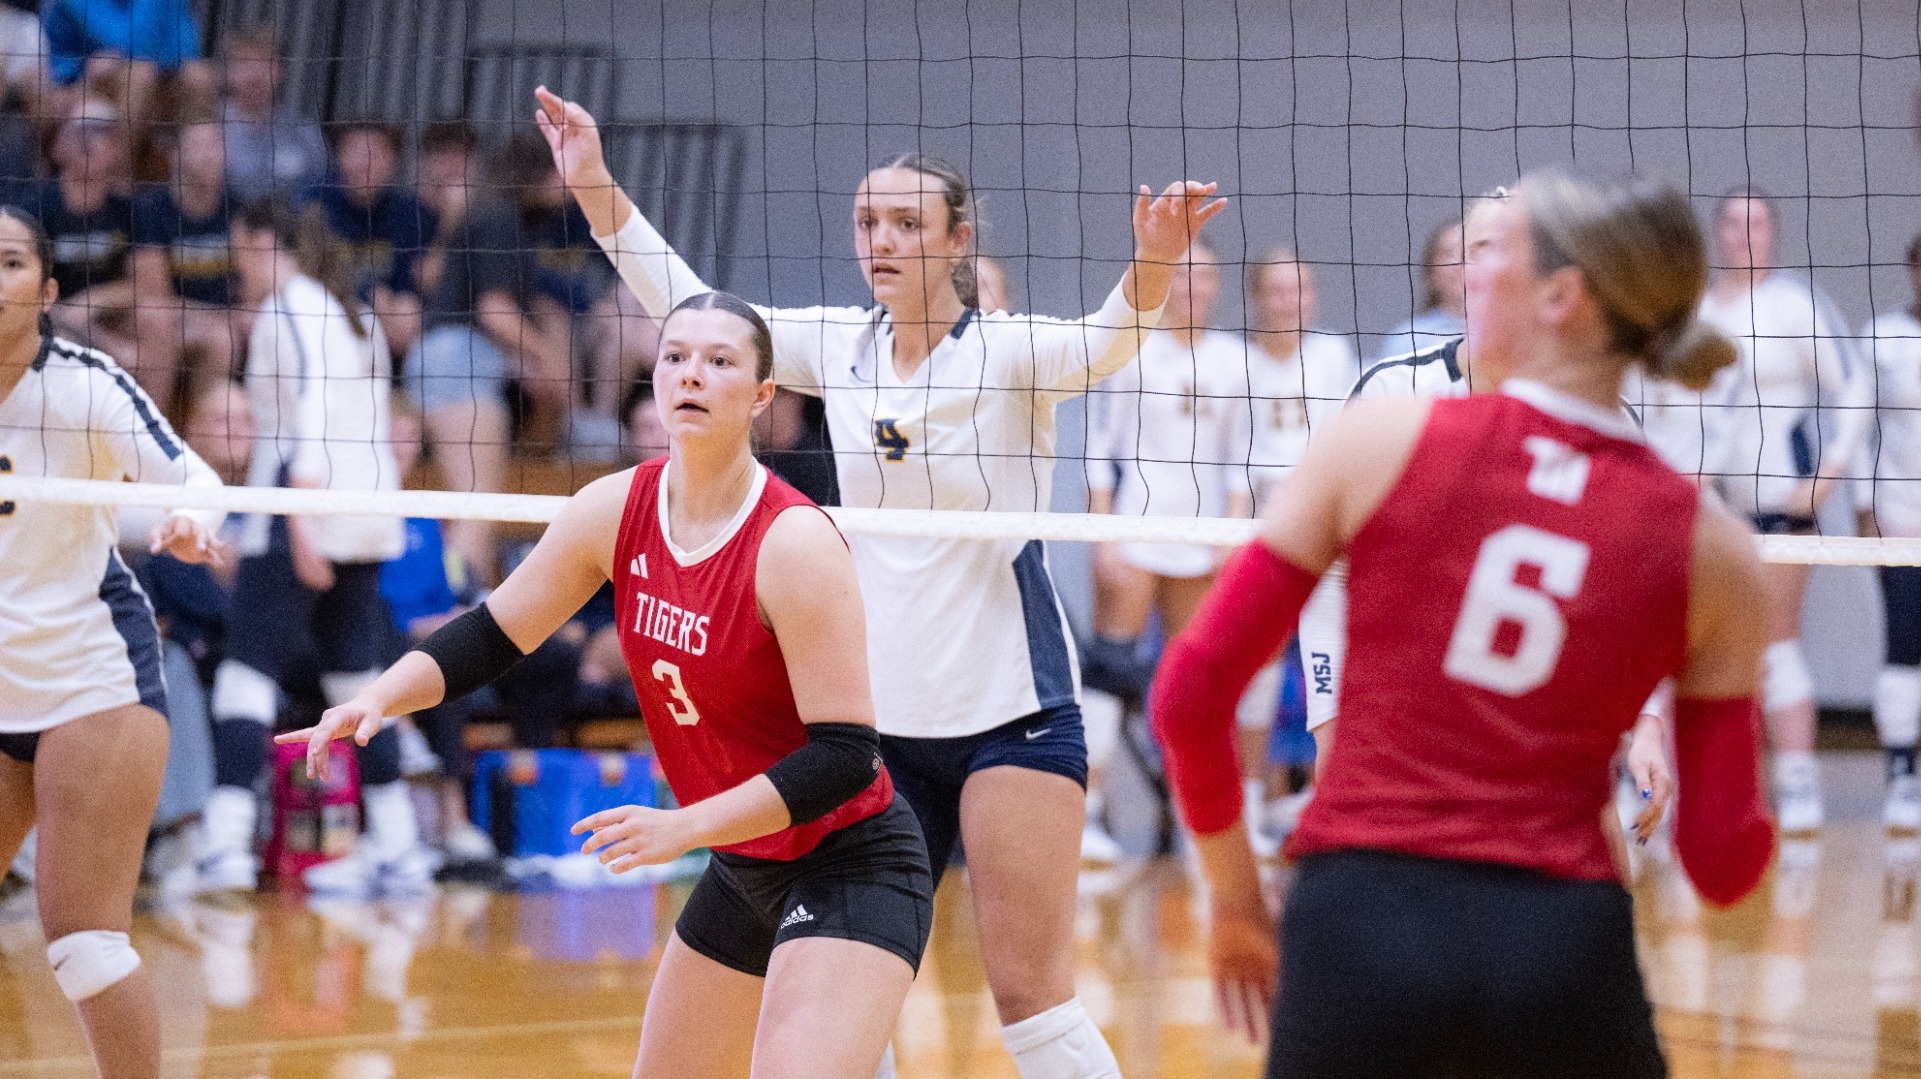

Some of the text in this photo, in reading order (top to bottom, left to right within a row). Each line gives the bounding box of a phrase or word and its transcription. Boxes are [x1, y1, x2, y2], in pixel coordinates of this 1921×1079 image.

[875, 418, 910, 463] 4
[633, 591, 710, 657] TIGERS
[1443, 524, 1590, 697] 6
[651, 658, 700, 726] 3
[1311, 651, 1333, 695] MSJ
[780, 913, 814, 930] adidas
